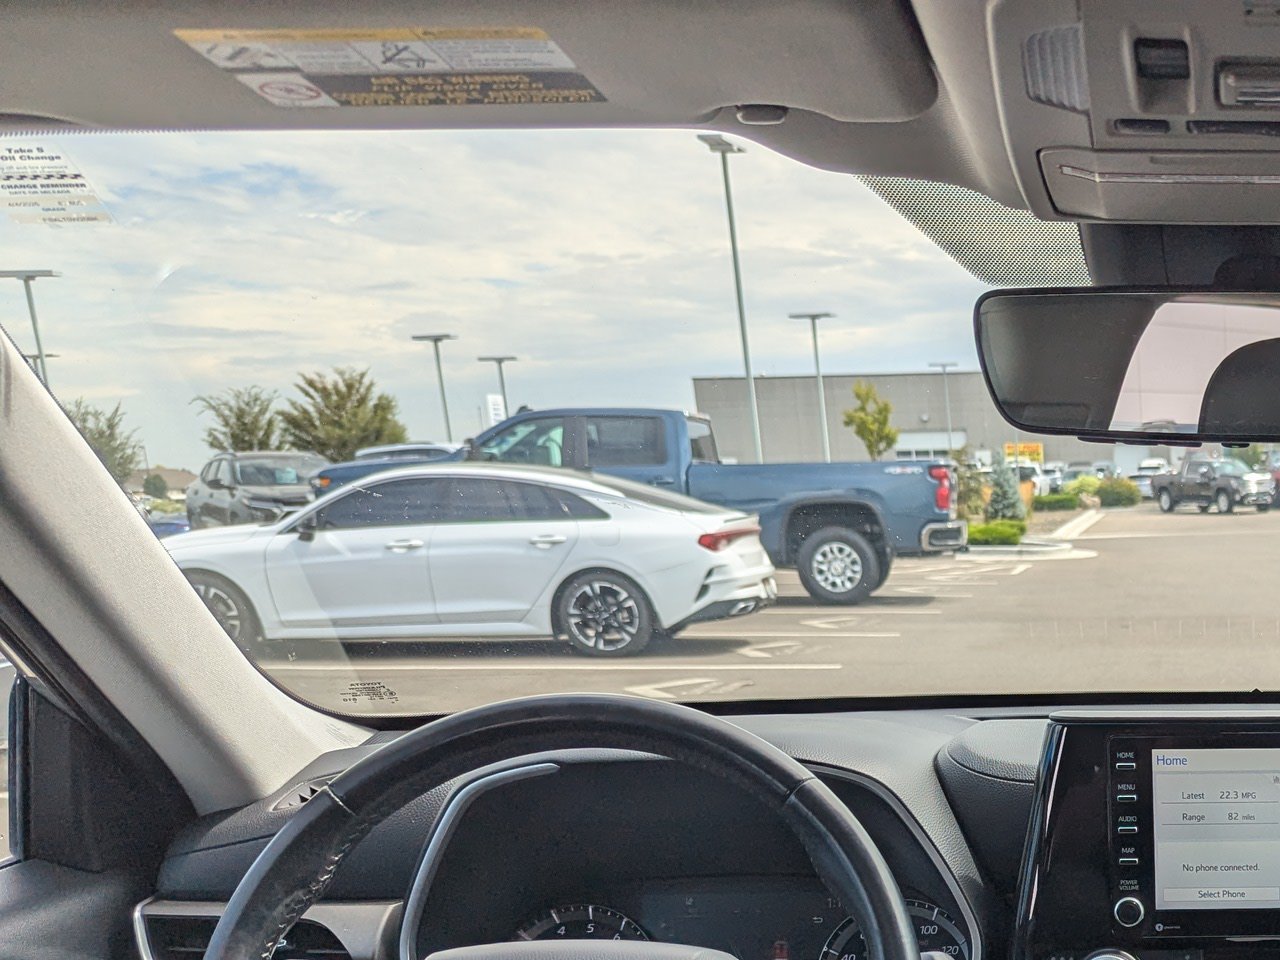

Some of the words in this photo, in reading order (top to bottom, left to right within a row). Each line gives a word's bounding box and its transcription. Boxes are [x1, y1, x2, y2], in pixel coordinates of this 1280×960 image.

[1156, 755, 1188, 766] Home
[1181, 791, 1205, 800] Latest
[1219, 791, 1239, 800] 22.3
[1241, 792, 1257, 800] MPG
[1182, 813, 1206, 823] Range
[1227, 812, 1239, 821] 82
[1241, 813, 1256, 821] miles
[1182, 863, 1194, 872] No
[1195, 863, 1219, 875] phone
[1219, 862, 1260, 872] connected.
[1198, 890, 1221, 899] Select
[1222, 889, 1246, 898] Phone
[557, 925, 566, 936] 4
[586, 923, 595, 933] 5
[919, 925, 939, 935] 100
